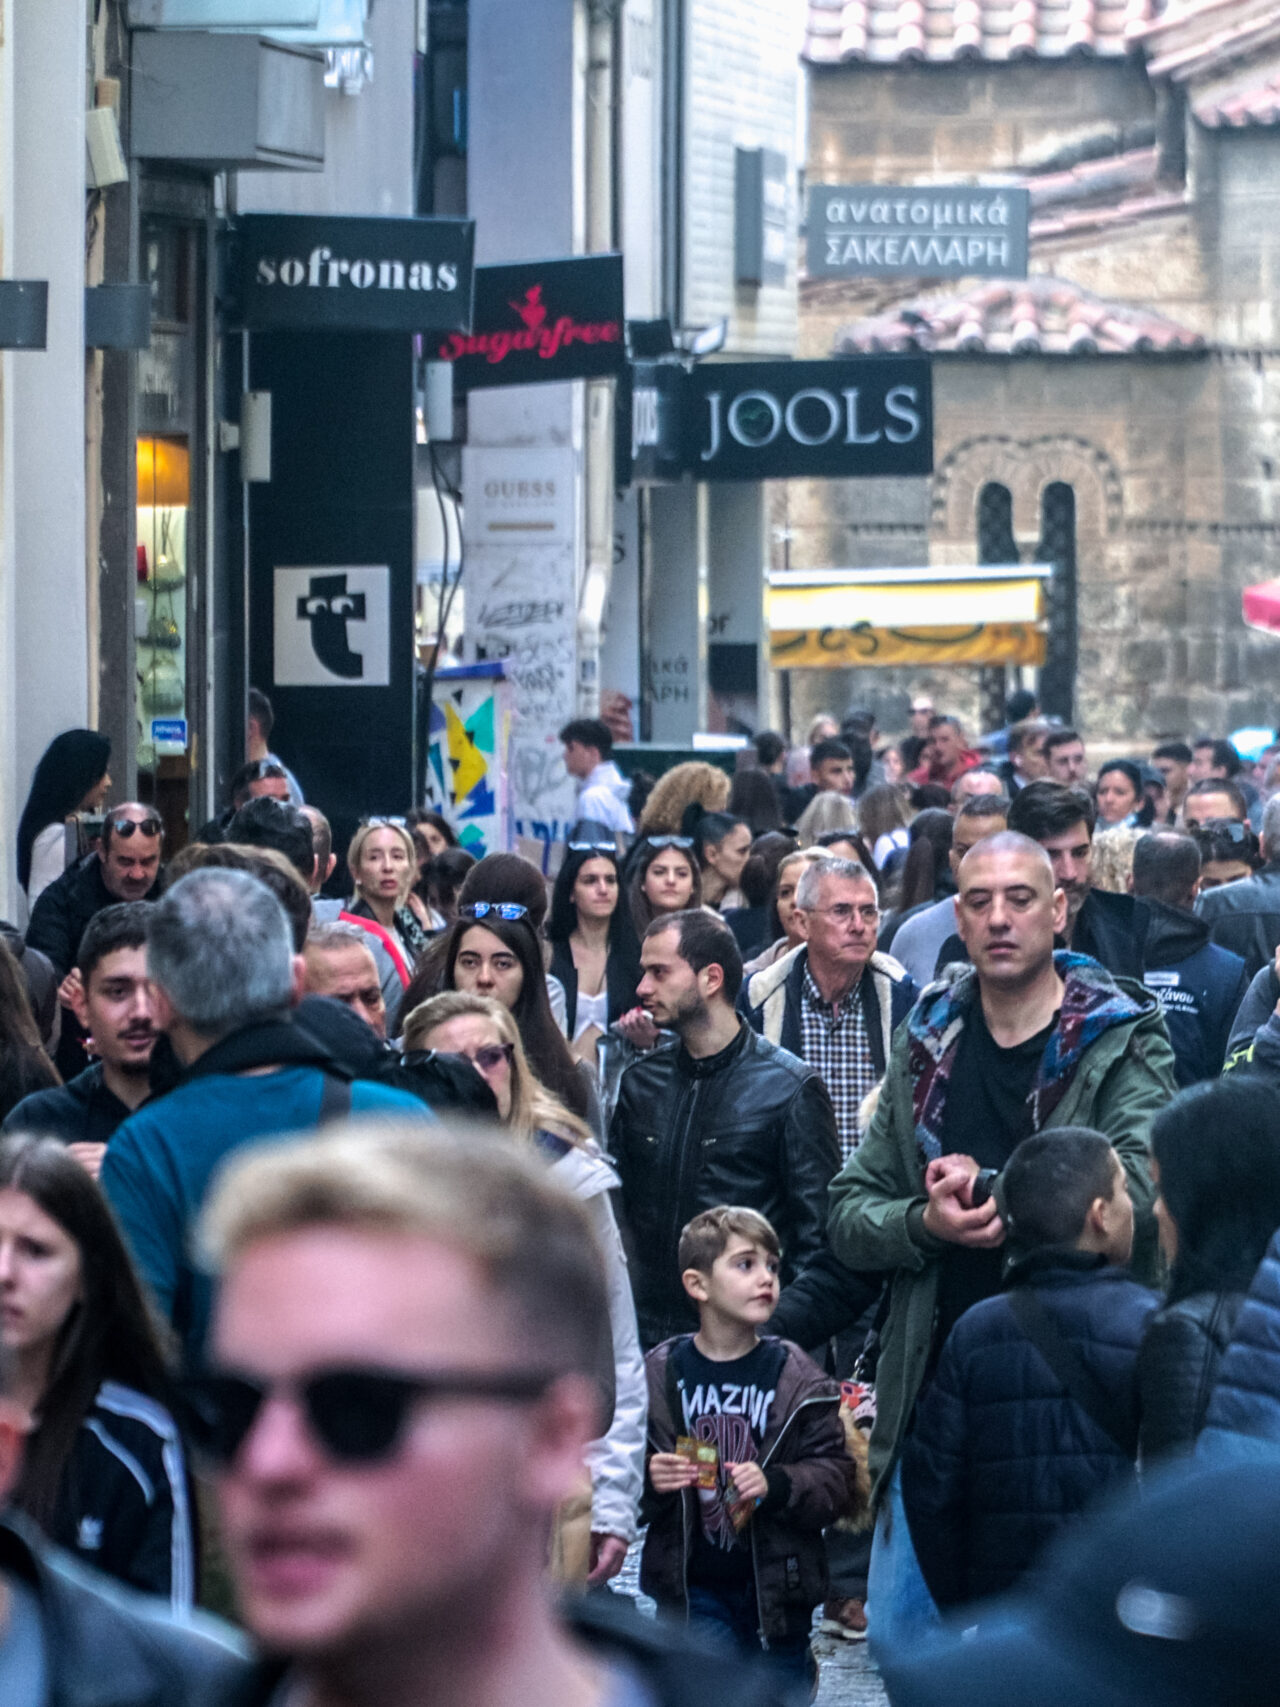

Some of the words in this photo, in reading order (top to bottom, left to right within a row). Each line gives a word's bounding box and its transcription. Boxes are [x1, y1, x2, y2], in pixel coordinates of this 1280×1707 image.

[826, 194, 1008, 231] ανατομικά
[255, 247, 458, 292] sofronas
[825, 238, 1009, 267] ΣΑΚΕΛΛΑΡΗ
[700, 384, 922, 461] JOOLS
